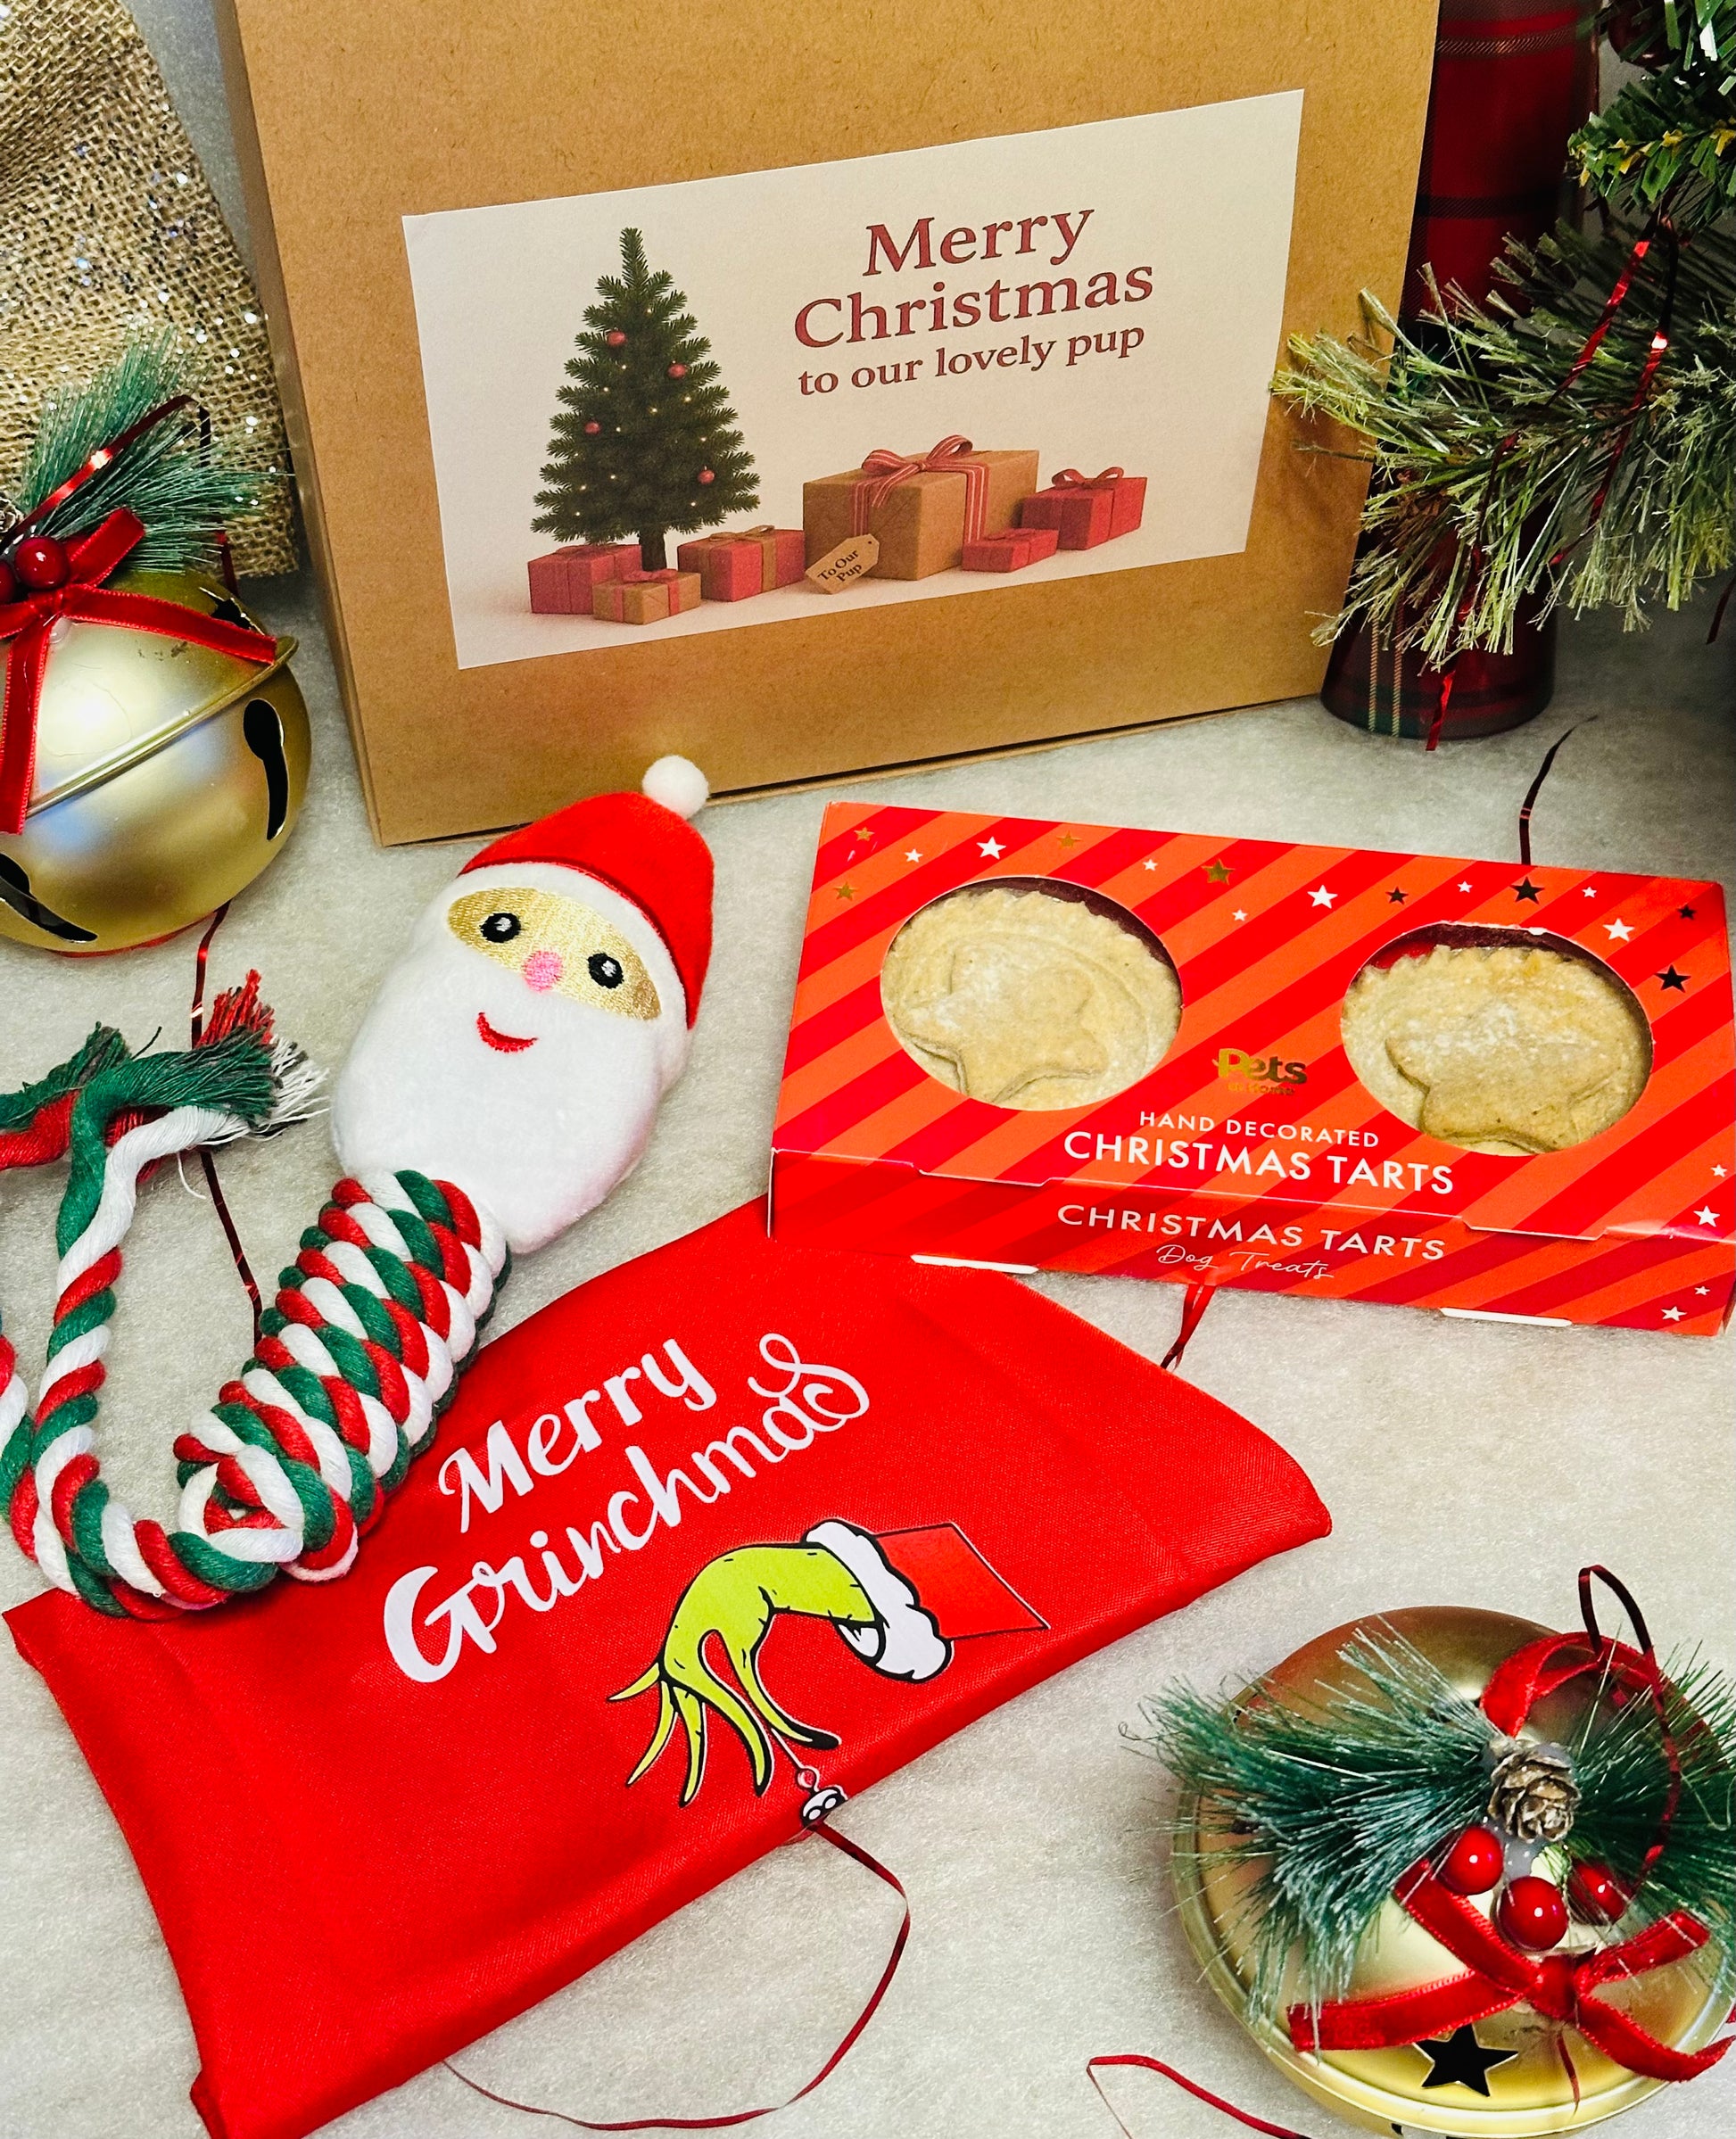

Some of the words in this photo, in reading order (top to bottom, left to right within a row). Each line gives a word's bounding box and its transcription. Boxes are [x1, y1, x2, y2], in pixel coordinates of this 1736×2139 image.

[863, 209, 1095, 276] Merry
[794, 266, 1153, 348] Christmas
[798, 370, 839, 396] to
[851, 359, 923, 389] our
[935, 334, 1057, 377] lovely
[1066, 326, 1145, 367] pup
[817, 567, 837, 580] To
[835, 550, 859, 569] Our
[836, 564, 863, 582] Pup
[1213, 1047, 1308, 1085] Pets
[1139, 1111, 1215, 1133] HAND
[1226, 1119, 1379, 1148] DECORATED
[1064, 1130, 1311, 1181] CHRISTMAS
[1327, 1155, 1454, 1194] TARTS
[1057, 1204, 1303, 1247] CHRISTMAS
[1320, 1229, 1446, 1260] TARTS
[1154, 1244, 1219, 1272] Dog
[1228, 1251, 1335, 1280] Treats
[438, 1338, 717, 1533] Merry
[383, 1333, 871, 1683] Grinchmas
